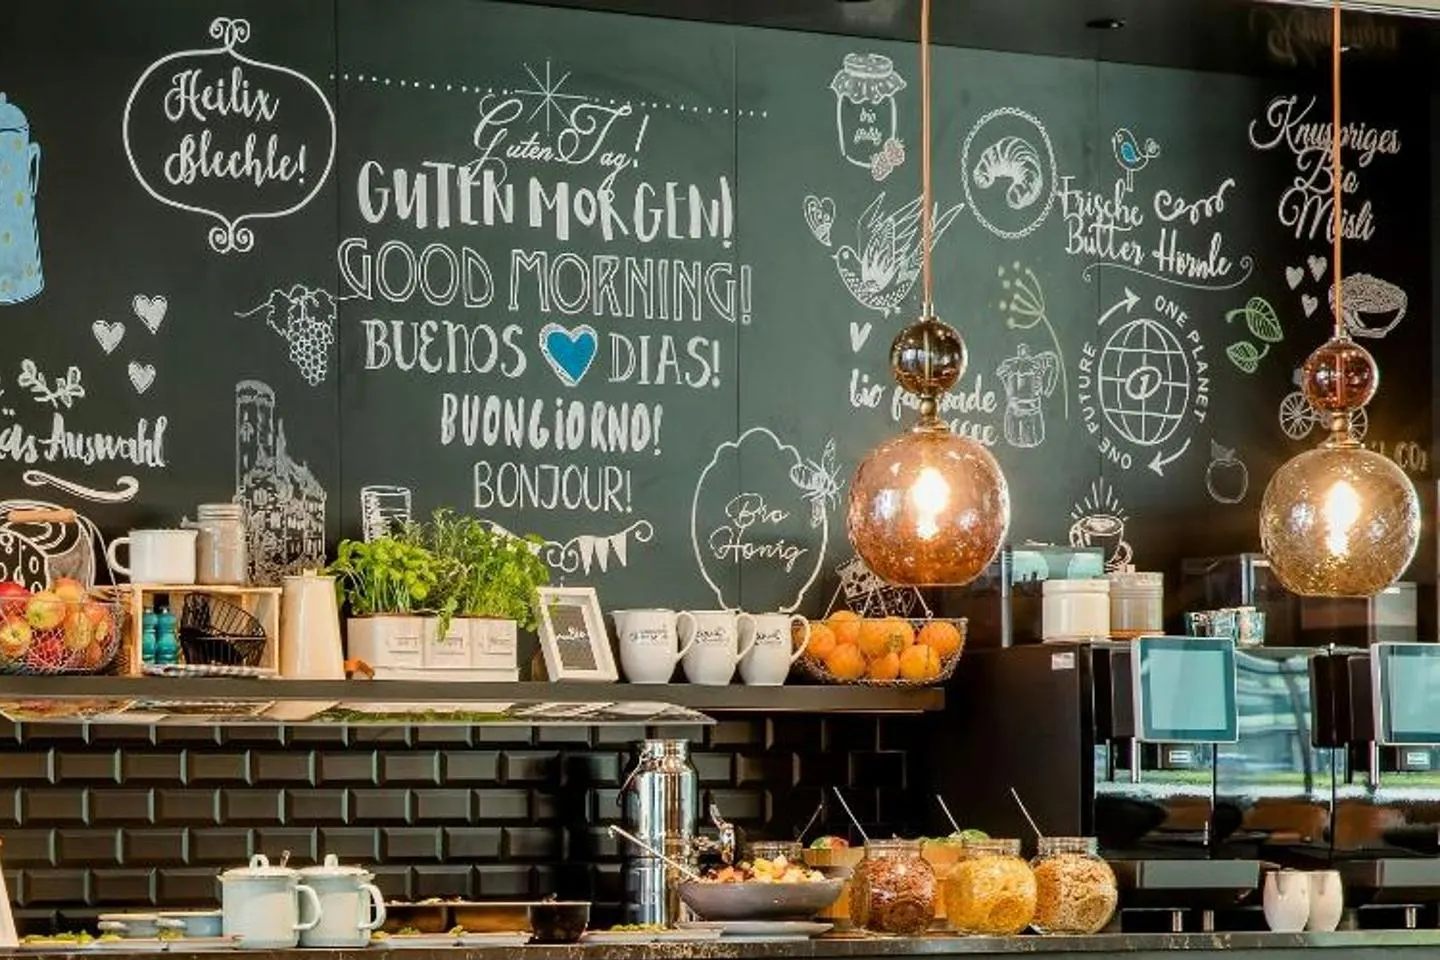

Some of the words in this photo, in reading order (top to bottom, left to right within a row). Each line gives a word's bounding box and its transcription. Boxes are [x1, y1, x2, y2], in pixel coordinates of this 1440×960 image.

[164, 66, 279, 122] Heilix
[164, 129, 306, 187] Blechle!
[464, 94, 556, 188] Guten
[556, 103, 650, 192] Tag!
[357, 160, 514, 229] GUTEN
[528, 176, 734, 248] MORGEN!
[1060, 175, 1144, 227] Frische
[1064, 212, 1146, 266] Butter
[1152, 227, 1233, 280] Hörnle
[337, 238, 495, 309] GOOD
[509, 249, 752, 325] MORNING!
[361, 319, 527, 379] BUENOS
[608, 332, 722, 388] DIAS!
[1154, 294, 1188, 329] ONE
[1187, 329, 1210, 424] PLANET
[849, 368, 885, 408] bio
[1078, 341, 1100, 434] FUTURE
[39, 412, 169, 468] Auswahl
[1097, 436, 1132, 470] ONE
[474, 460, 633, 513] BONJOUR!
[708, 526, 809, 574] Honig
